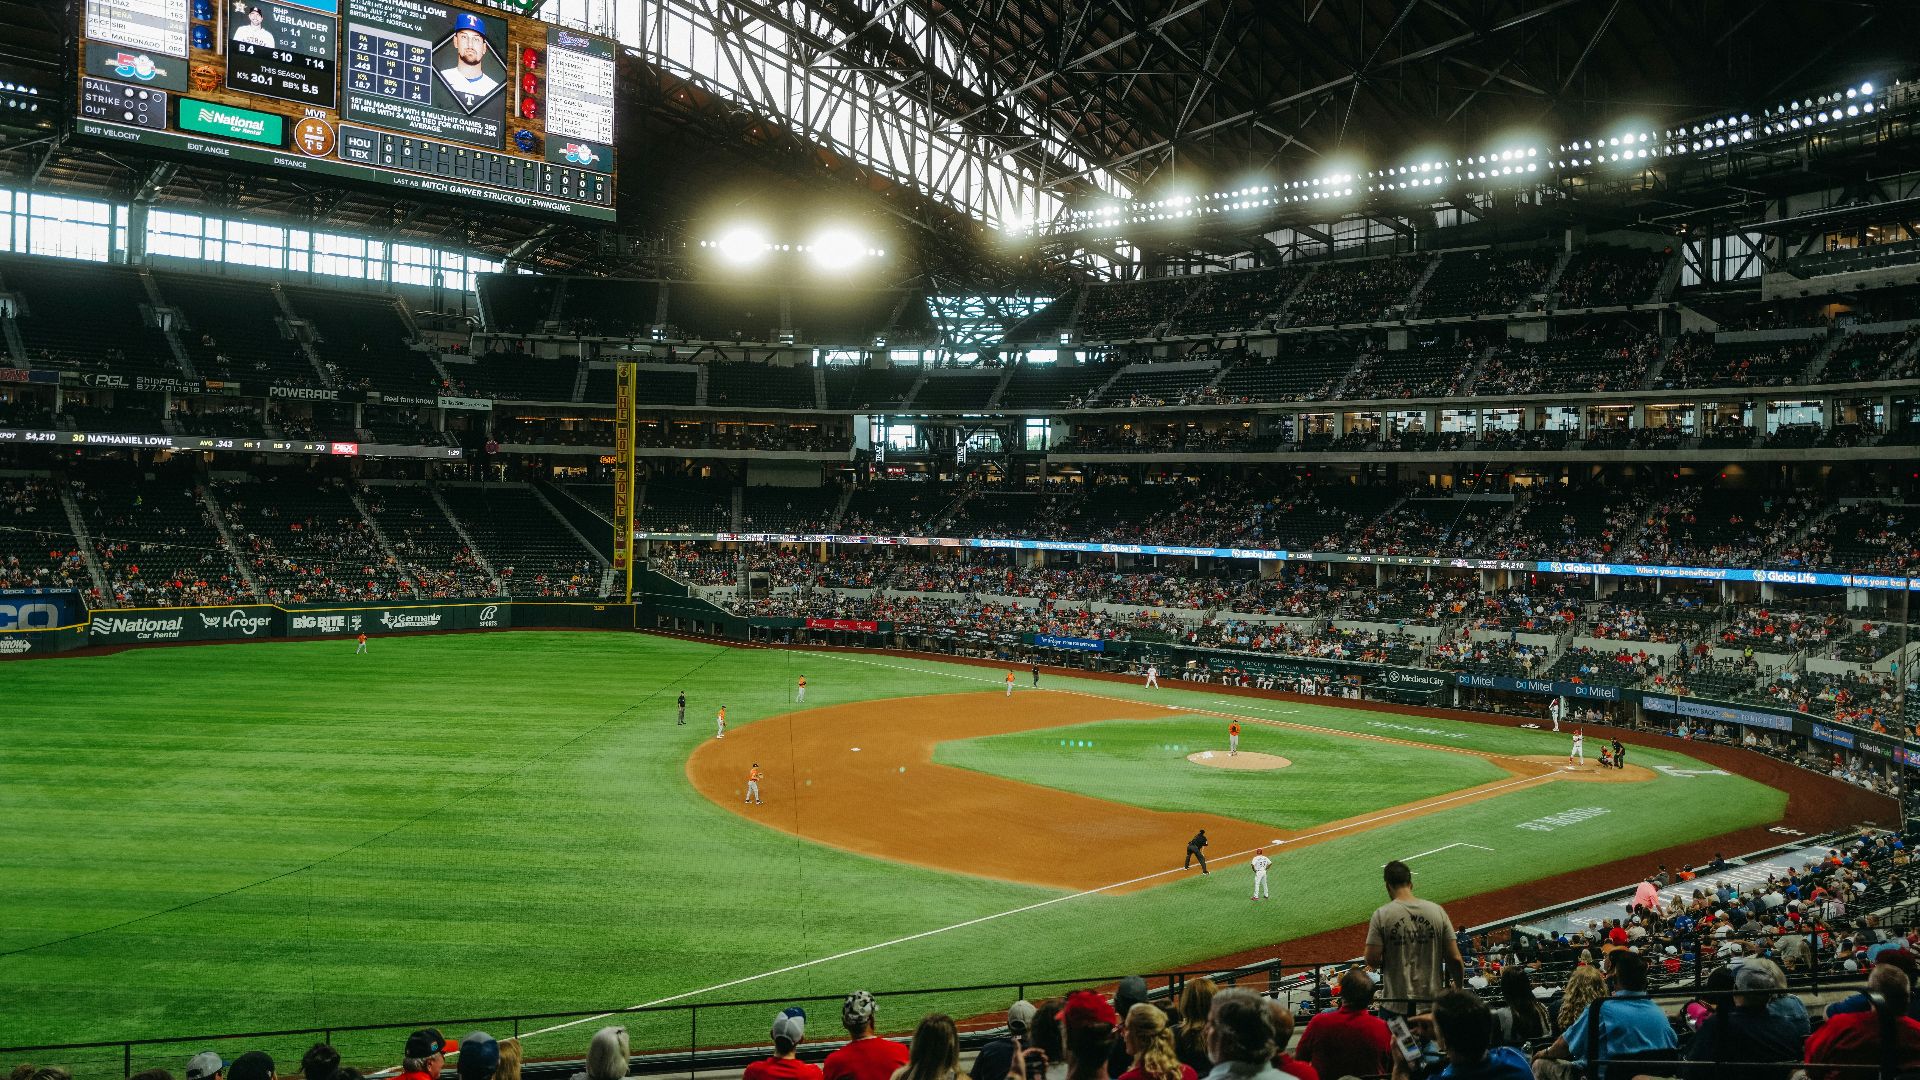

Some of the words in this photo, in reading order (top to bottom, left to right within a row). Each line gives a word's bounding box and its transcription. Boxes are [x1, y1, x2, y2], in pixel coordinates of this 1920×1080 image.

[273, 7, 288, 15] RHP
[424, 6, 447, 18] LOWE
[273, 14, 328, 32] VERLANDER
[112, 34, 160, 48] MALDONADO
[280, 54, 293, 62] 10
[313, 60, 324, 69] 14
[261, 66, 276, 74] THIS
[278, 69, 306, 80] SEASON
[86, 81, 110, 92] BALL
[250, 73, 272, 85] 30.1
[282, 81, 299, 90] BB%
[302, 84, 318, 94] 5.5
[85, 94, 120, 105] STRIKE
[85, 106, 106, 115] OUT
[305, 108, 326, 118] MVR
[374, 101, 401, 112] MAJORS
[403, 107, 419, 115] WITH
[213, 113, 264, 130] National
[377, 109, 394, 117] WITH
[422, 117, 436, 125] TIED
[466, 126, 482, 134] WITH
[85, 126, 101, 134] EXIT
[104, 128, 140, 140] VELOCITY
[349, 137, 370, 149] HOU
[205, 145, 229, 156] ANGLE
[350, 149, 368, 159] TEX
[274, 158, 306, 169] DISTANCE
[422, 181, 448, 192] MITCH
[450, 186, 482, 197] GARVER
[483, 190, 513, 202] STRUCK
[515, 196, 530, 204] OUT
[533, 200, 570, 212] SWINGING
[96, 375, 129, 386] PGL
[136, 376, 200, 387] ShipPGL.com
[270, 387, 339, 400] POWERADE
[619, 386, 628, 419] THE
[25, 432, 56, 441] $4,210
[87, 435, 142, 445] NATHANIEL
[145, 437, 172, 446] LOWE
[618, 470, 626, 516] ZONE
[1564, 563, 1591, 573] Globe
[1593, 564, 1611, 573] Life
[1679, 569, 1726, 578] beneficiary?
[1768, 572, 1796, 582] Globe
[1798, 572, 1816, 583] Life
[222, 610, 271, 635] Kroger
[318, 616, 345, 628] BITE
[398, 613, 441, 622] Germania
[112, 617, 182, 632] National
[1402, 674, 1428, 683] Medical
[1429, 677, 1444, 686] City
[1472, 676, 1494, 686] Mitel
[1529, 681, 1552, 692] Mitel
[1589, 687, 1615, 698] Mitel
[1742, 714, 1773, 724] TONIGHT
[1860, 743, 1873, 752] Globe
